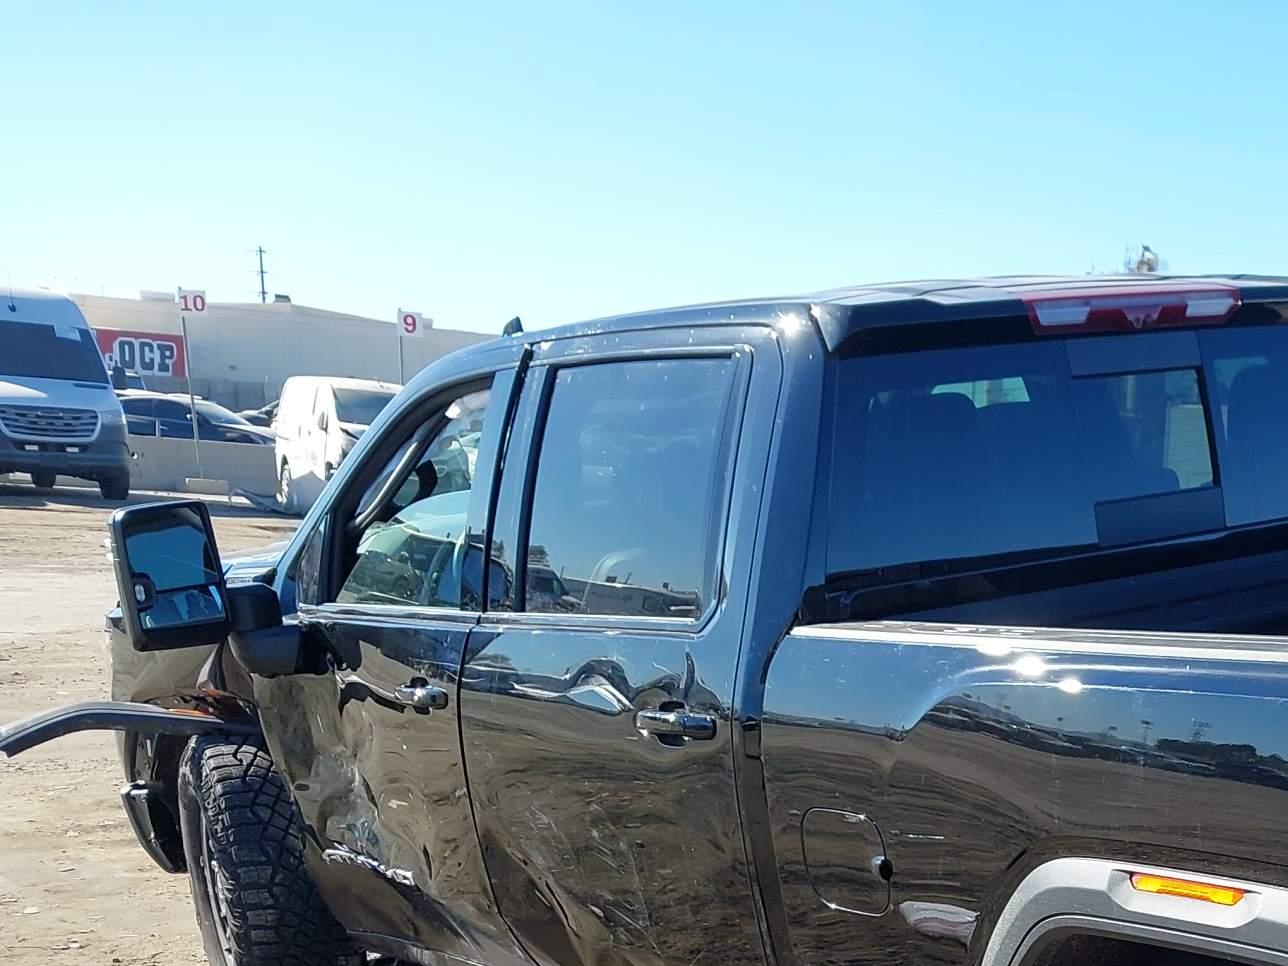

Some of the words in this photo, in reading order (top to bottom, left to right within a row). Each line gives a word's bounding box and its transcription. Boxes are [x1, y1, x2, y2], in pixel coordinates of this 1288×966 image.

[180, 294, 206, 312] 10
[402, 314, 417, 334] 9
[113, 336, 177, 376] OCP
